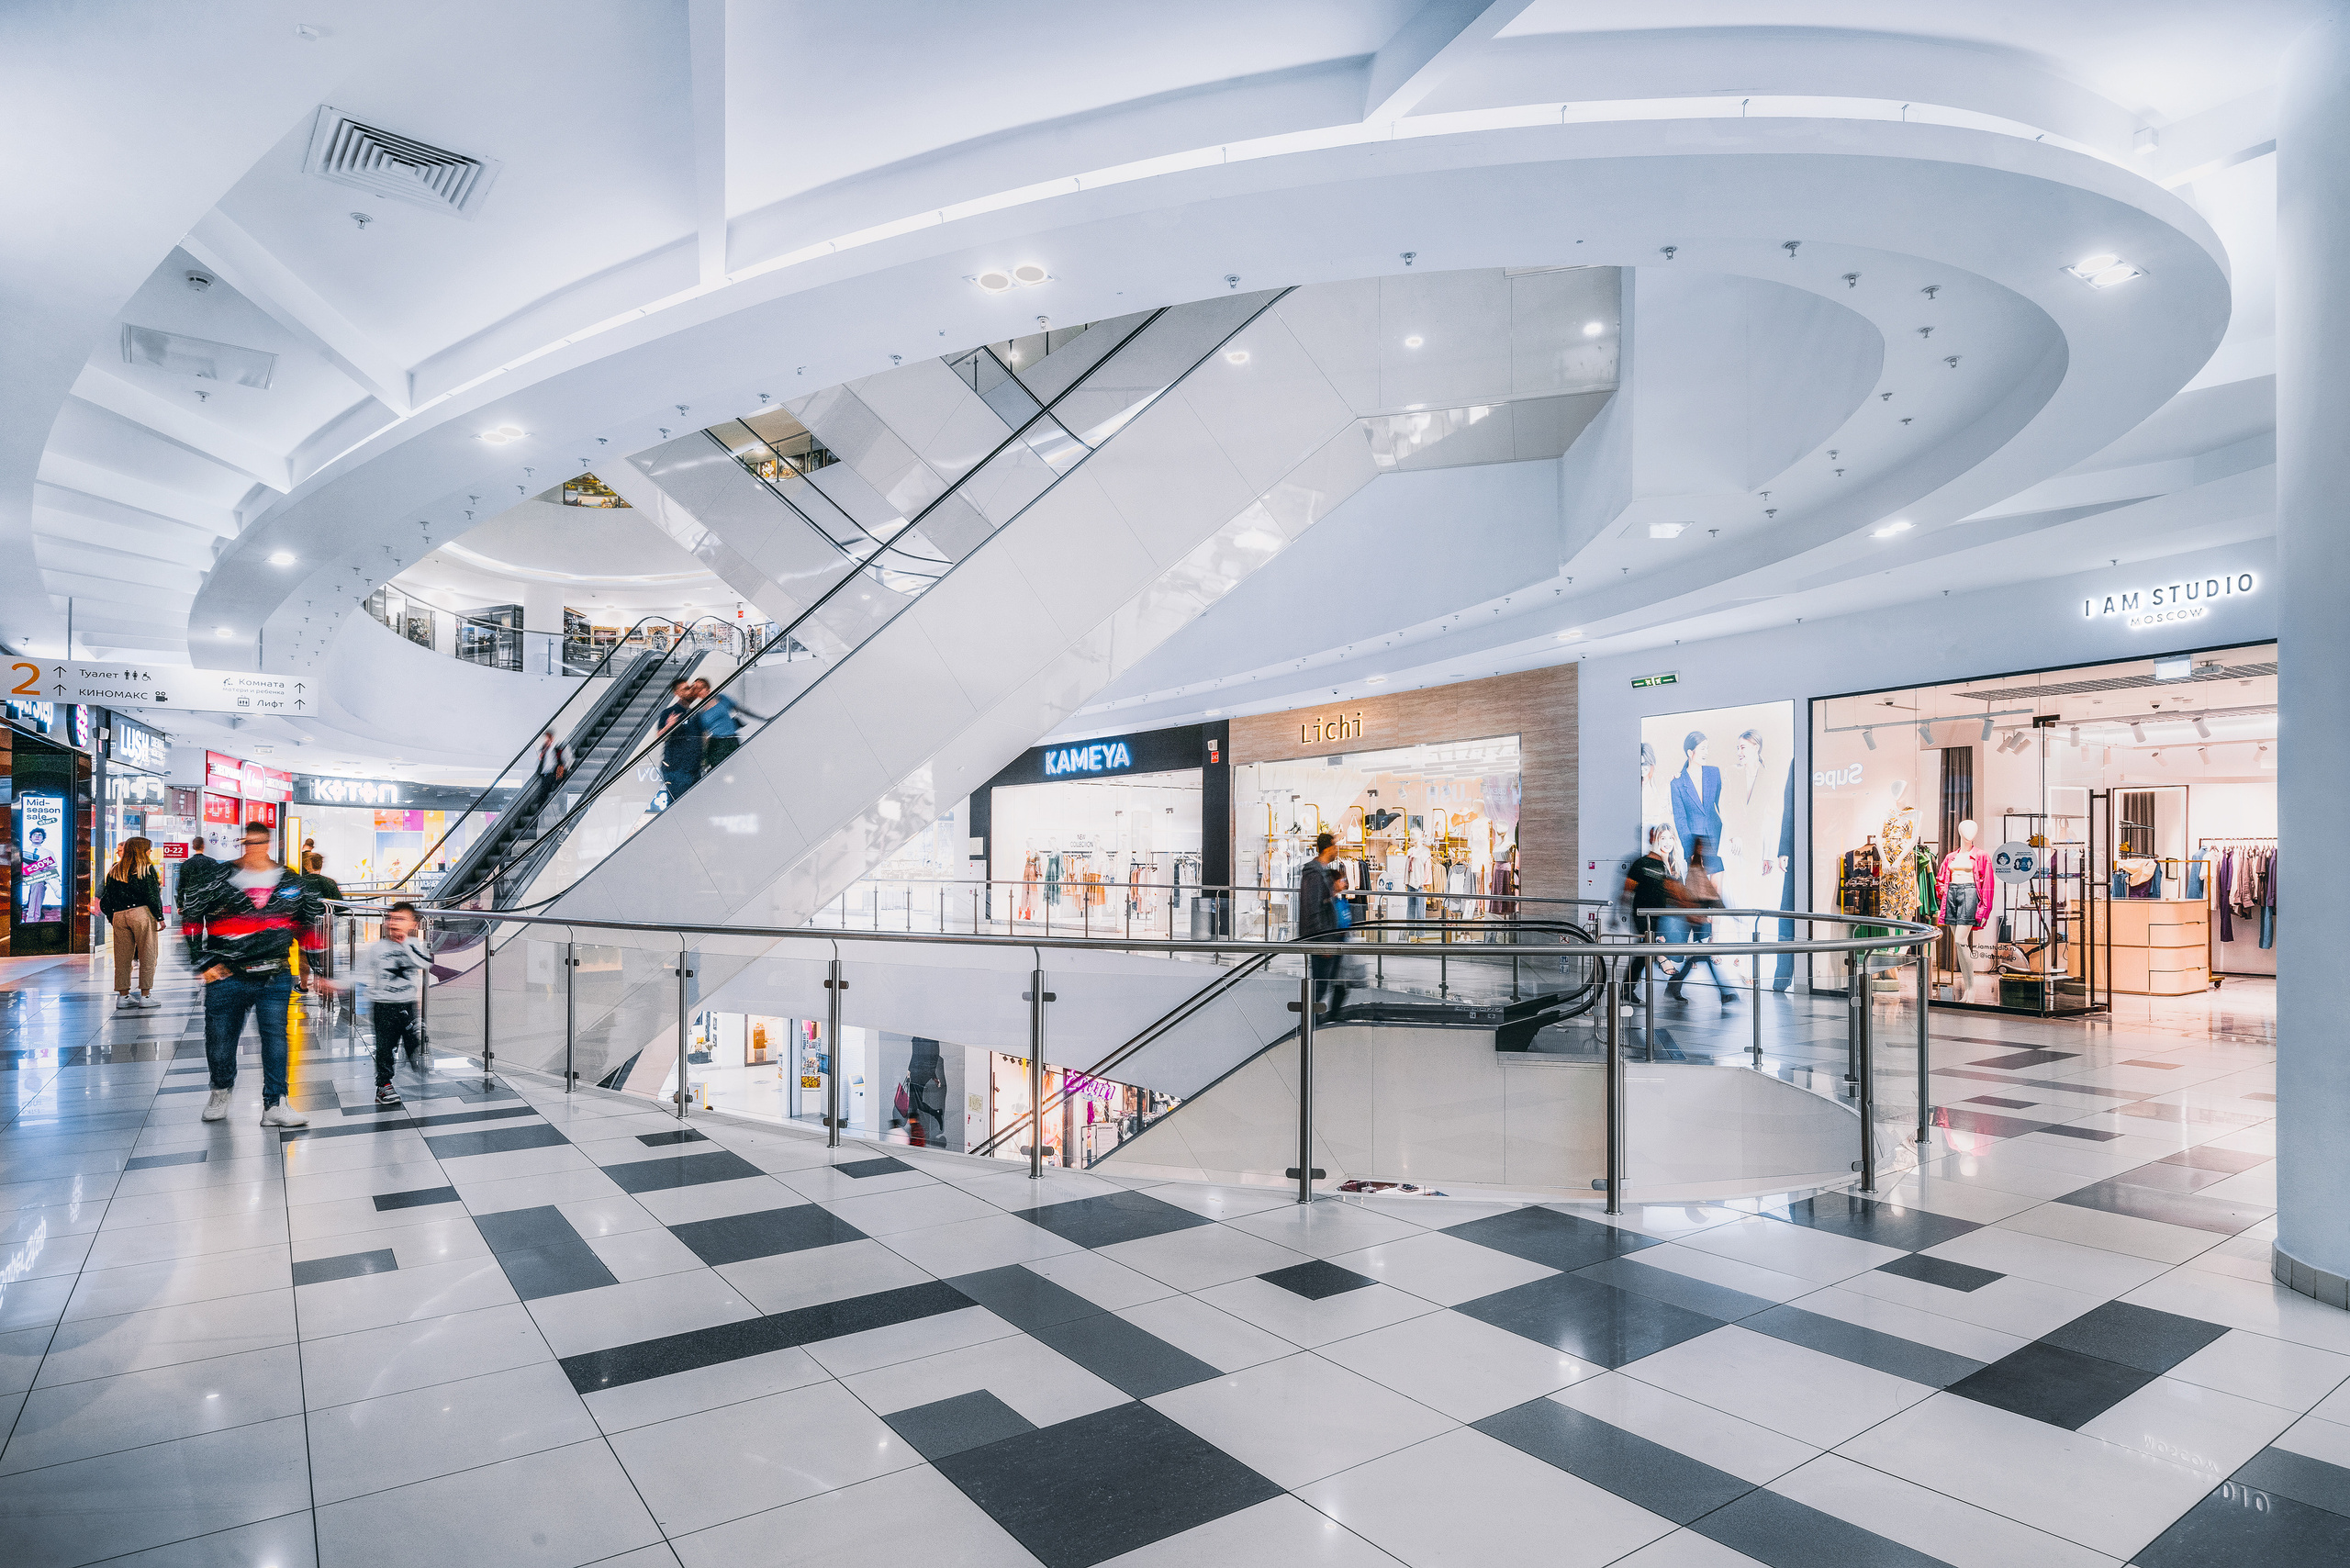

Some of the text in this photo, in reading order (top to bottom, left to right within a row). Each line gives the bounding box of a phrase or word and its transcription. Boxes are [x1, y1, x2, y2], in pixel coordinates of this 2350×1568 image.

[2085, 573, 2254, 617] I AM STUDIO
[2130, 607, 2203, 626] MOSCOW
[11, 662, 41, 696] 2
[79, 668, 119, 679] Туалет
[239, 678, 285, 689] Комната
[79, 689, 149, 700] КИНОМАКС
[256, 700, 285, 709] Лифт
[1301, 711, 1364, 745] Lichi
[120, 723, 150, 763] LUSH
[1045, 742, 1130, 775] KAMEYA
[26, 799, 50, 807] Mid-
[26, 812, 48, 821] sale
[1960, 943, 2017, 952] www.iamstudio.ru
[1979, 952, 2017, 961] @iamstudio
[693, 1089, 699, 1100] 1
